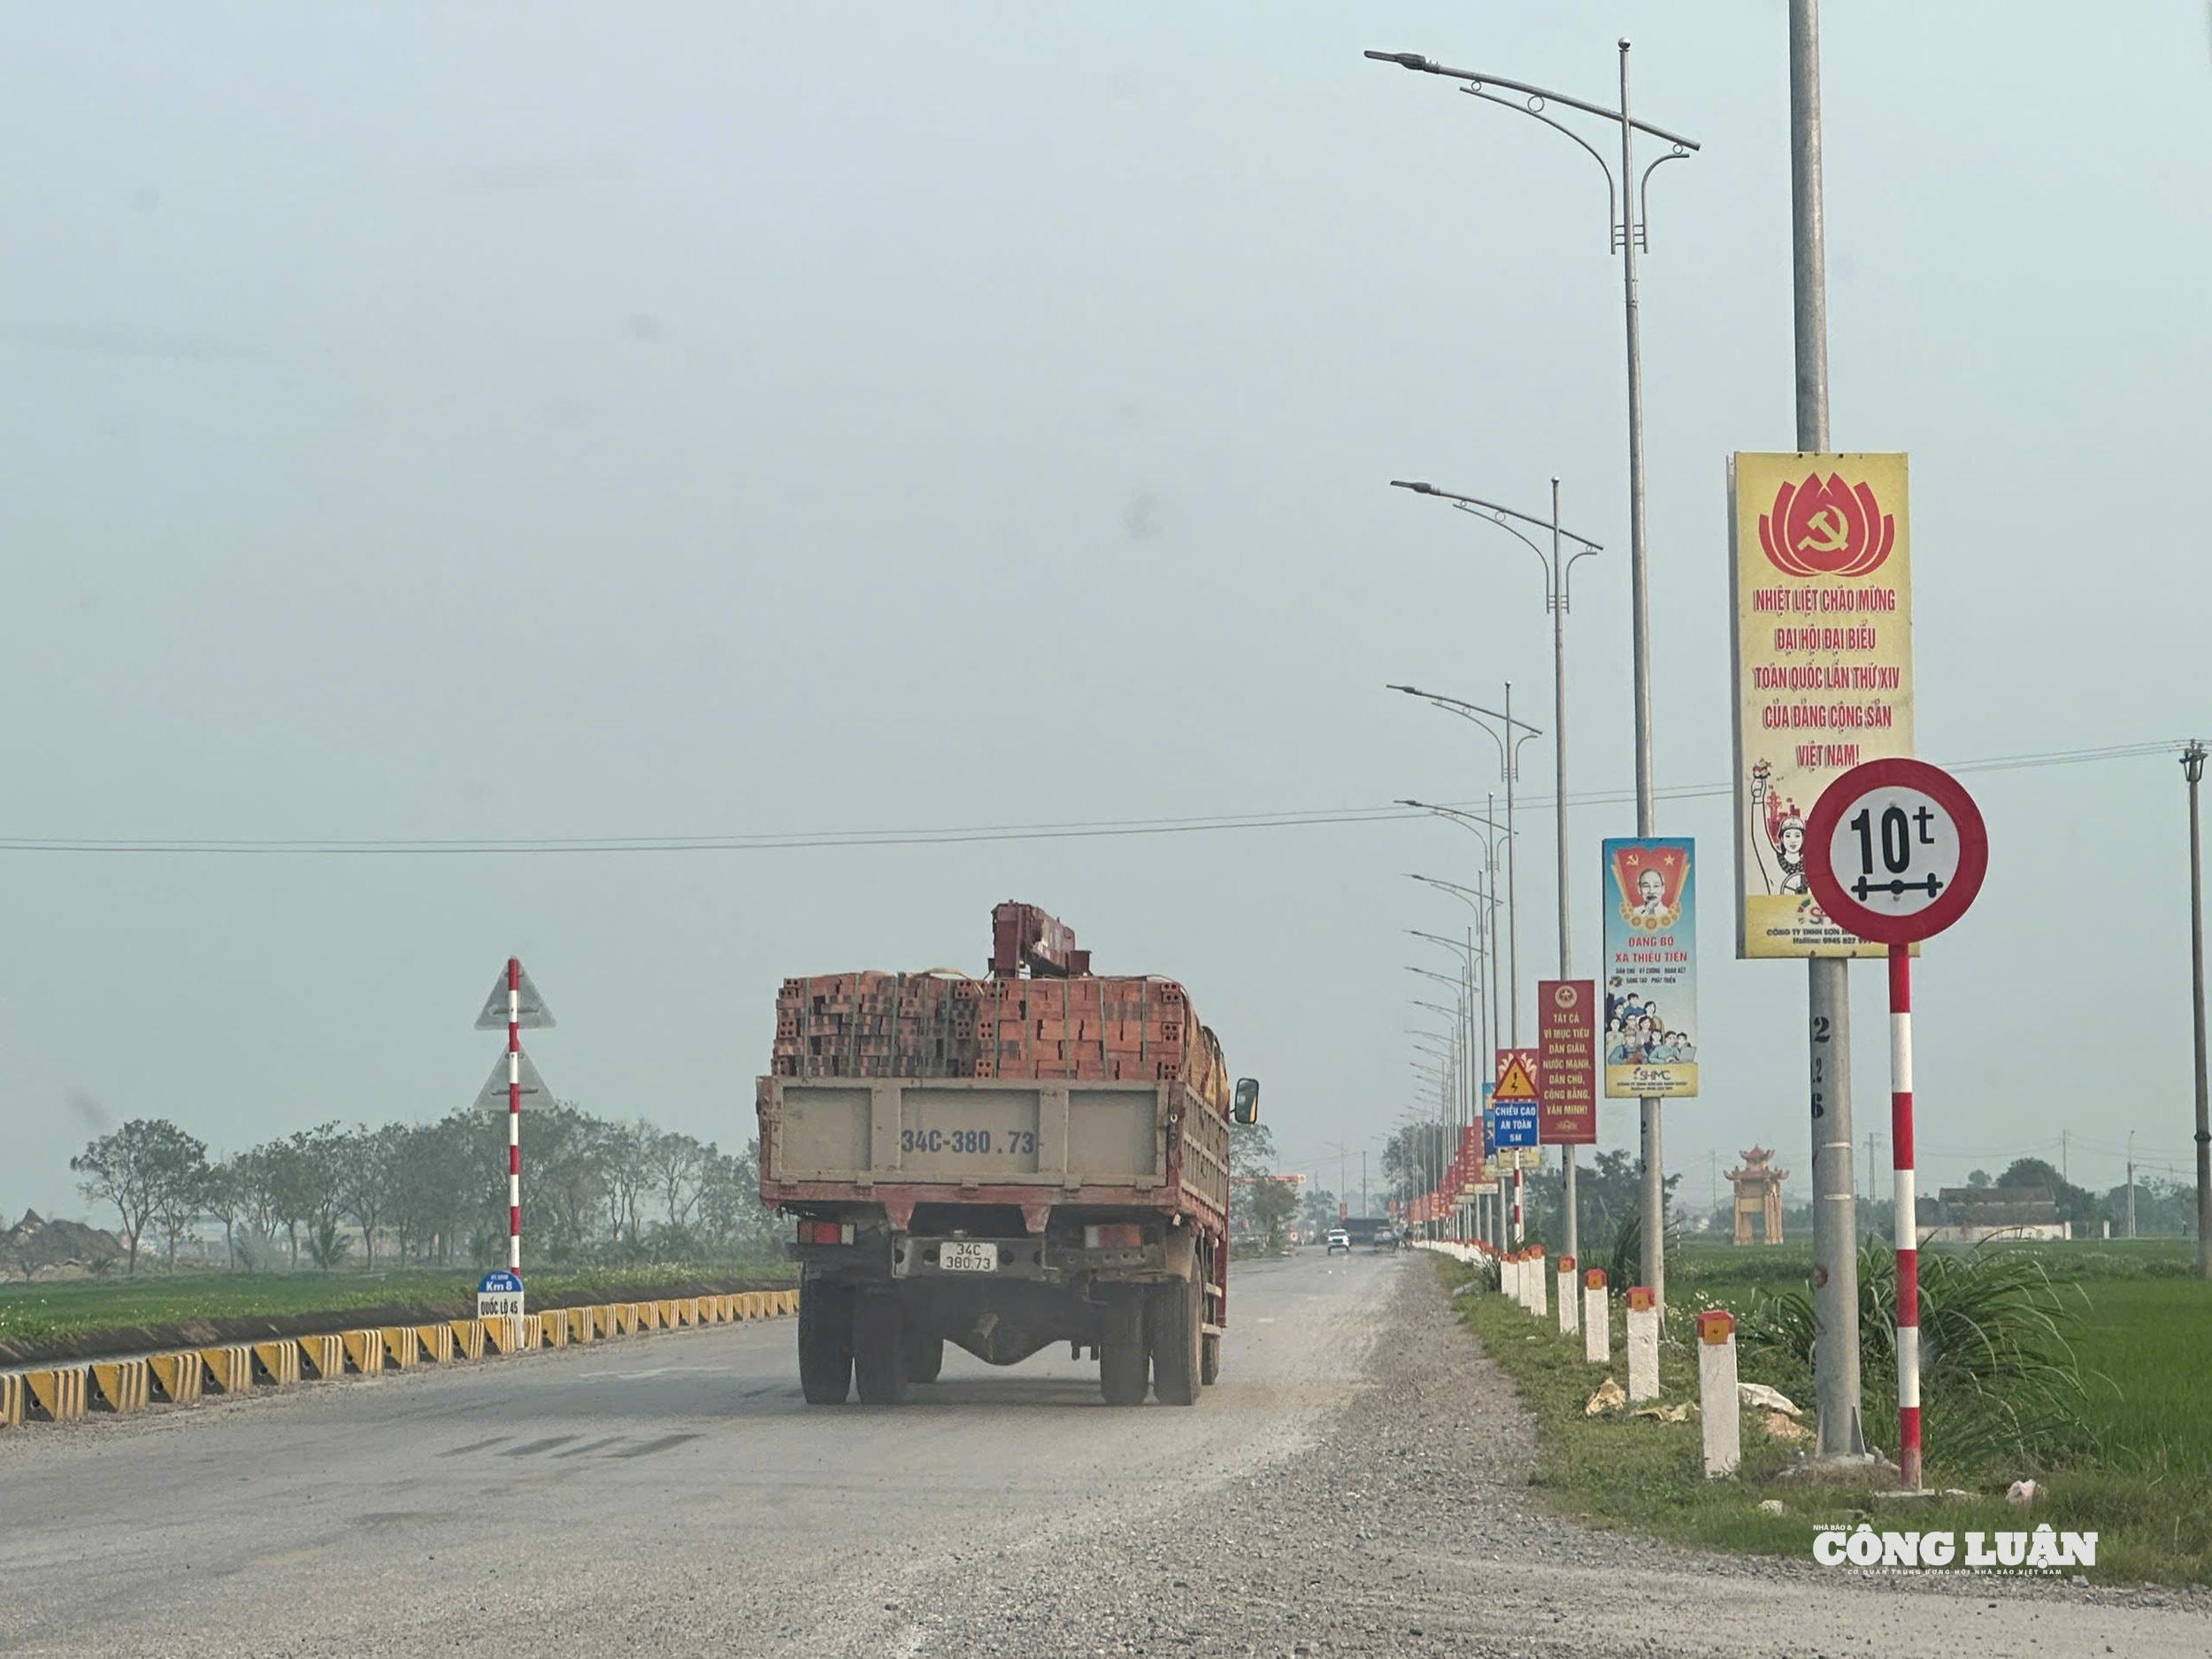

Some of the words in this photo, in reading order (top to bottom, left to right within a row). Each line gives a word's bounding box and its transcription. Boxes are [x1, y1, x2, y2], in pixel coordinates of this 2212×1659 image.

[1755, 585, 1791, 616] NHIỆT
[1794, 585, 1818, 616] LIỆT
[1822, 585, 1855, 611] CHÀO
[1858, 585, 1895, 611] MỪNG
[1777, 627, 1797, 656] ĐẠI
[1801, 624, 1820, 656] HỘI
[1824, 627, 1844, 656] ĐẠI
[1848, 620, 1876, 649] BIỂU
[1755, 663, 1786, 688] TOÀN
[1791, 659, 1823, 691] QUỐC
[1826, 659, 1849, 688] LẦN
[1854, 663, 1878, 688] THỨ
[1880, 666, 1900, 688] XIV
[1764, 698, 1790, 727] CỦA
[1793, 698, 1826, 727] ĐẢNG
[1831, 702, 1863, 733] CỘNG
[1866, 698, 1892, 727] SẢN
[1797, 741, 1824, 772] VIỆT
[1826, 744, 1860, 767] NAM!
[1501, 1120, 1510, 1130] AN
[1513, 1118, 1532, 1130] TOÀN
[1520, 1107, 1535, 1116] CAO
[956, 1243, 981, 1256] 34C
[487, 1281, 503, 1291] Km
[506, 1280, 512, 1290] 8
[480, 1297, 498, 1316] QUỐC
[500, 1299, 509, 1317] LỘ
[511, 1302, 518, 1314] 45
